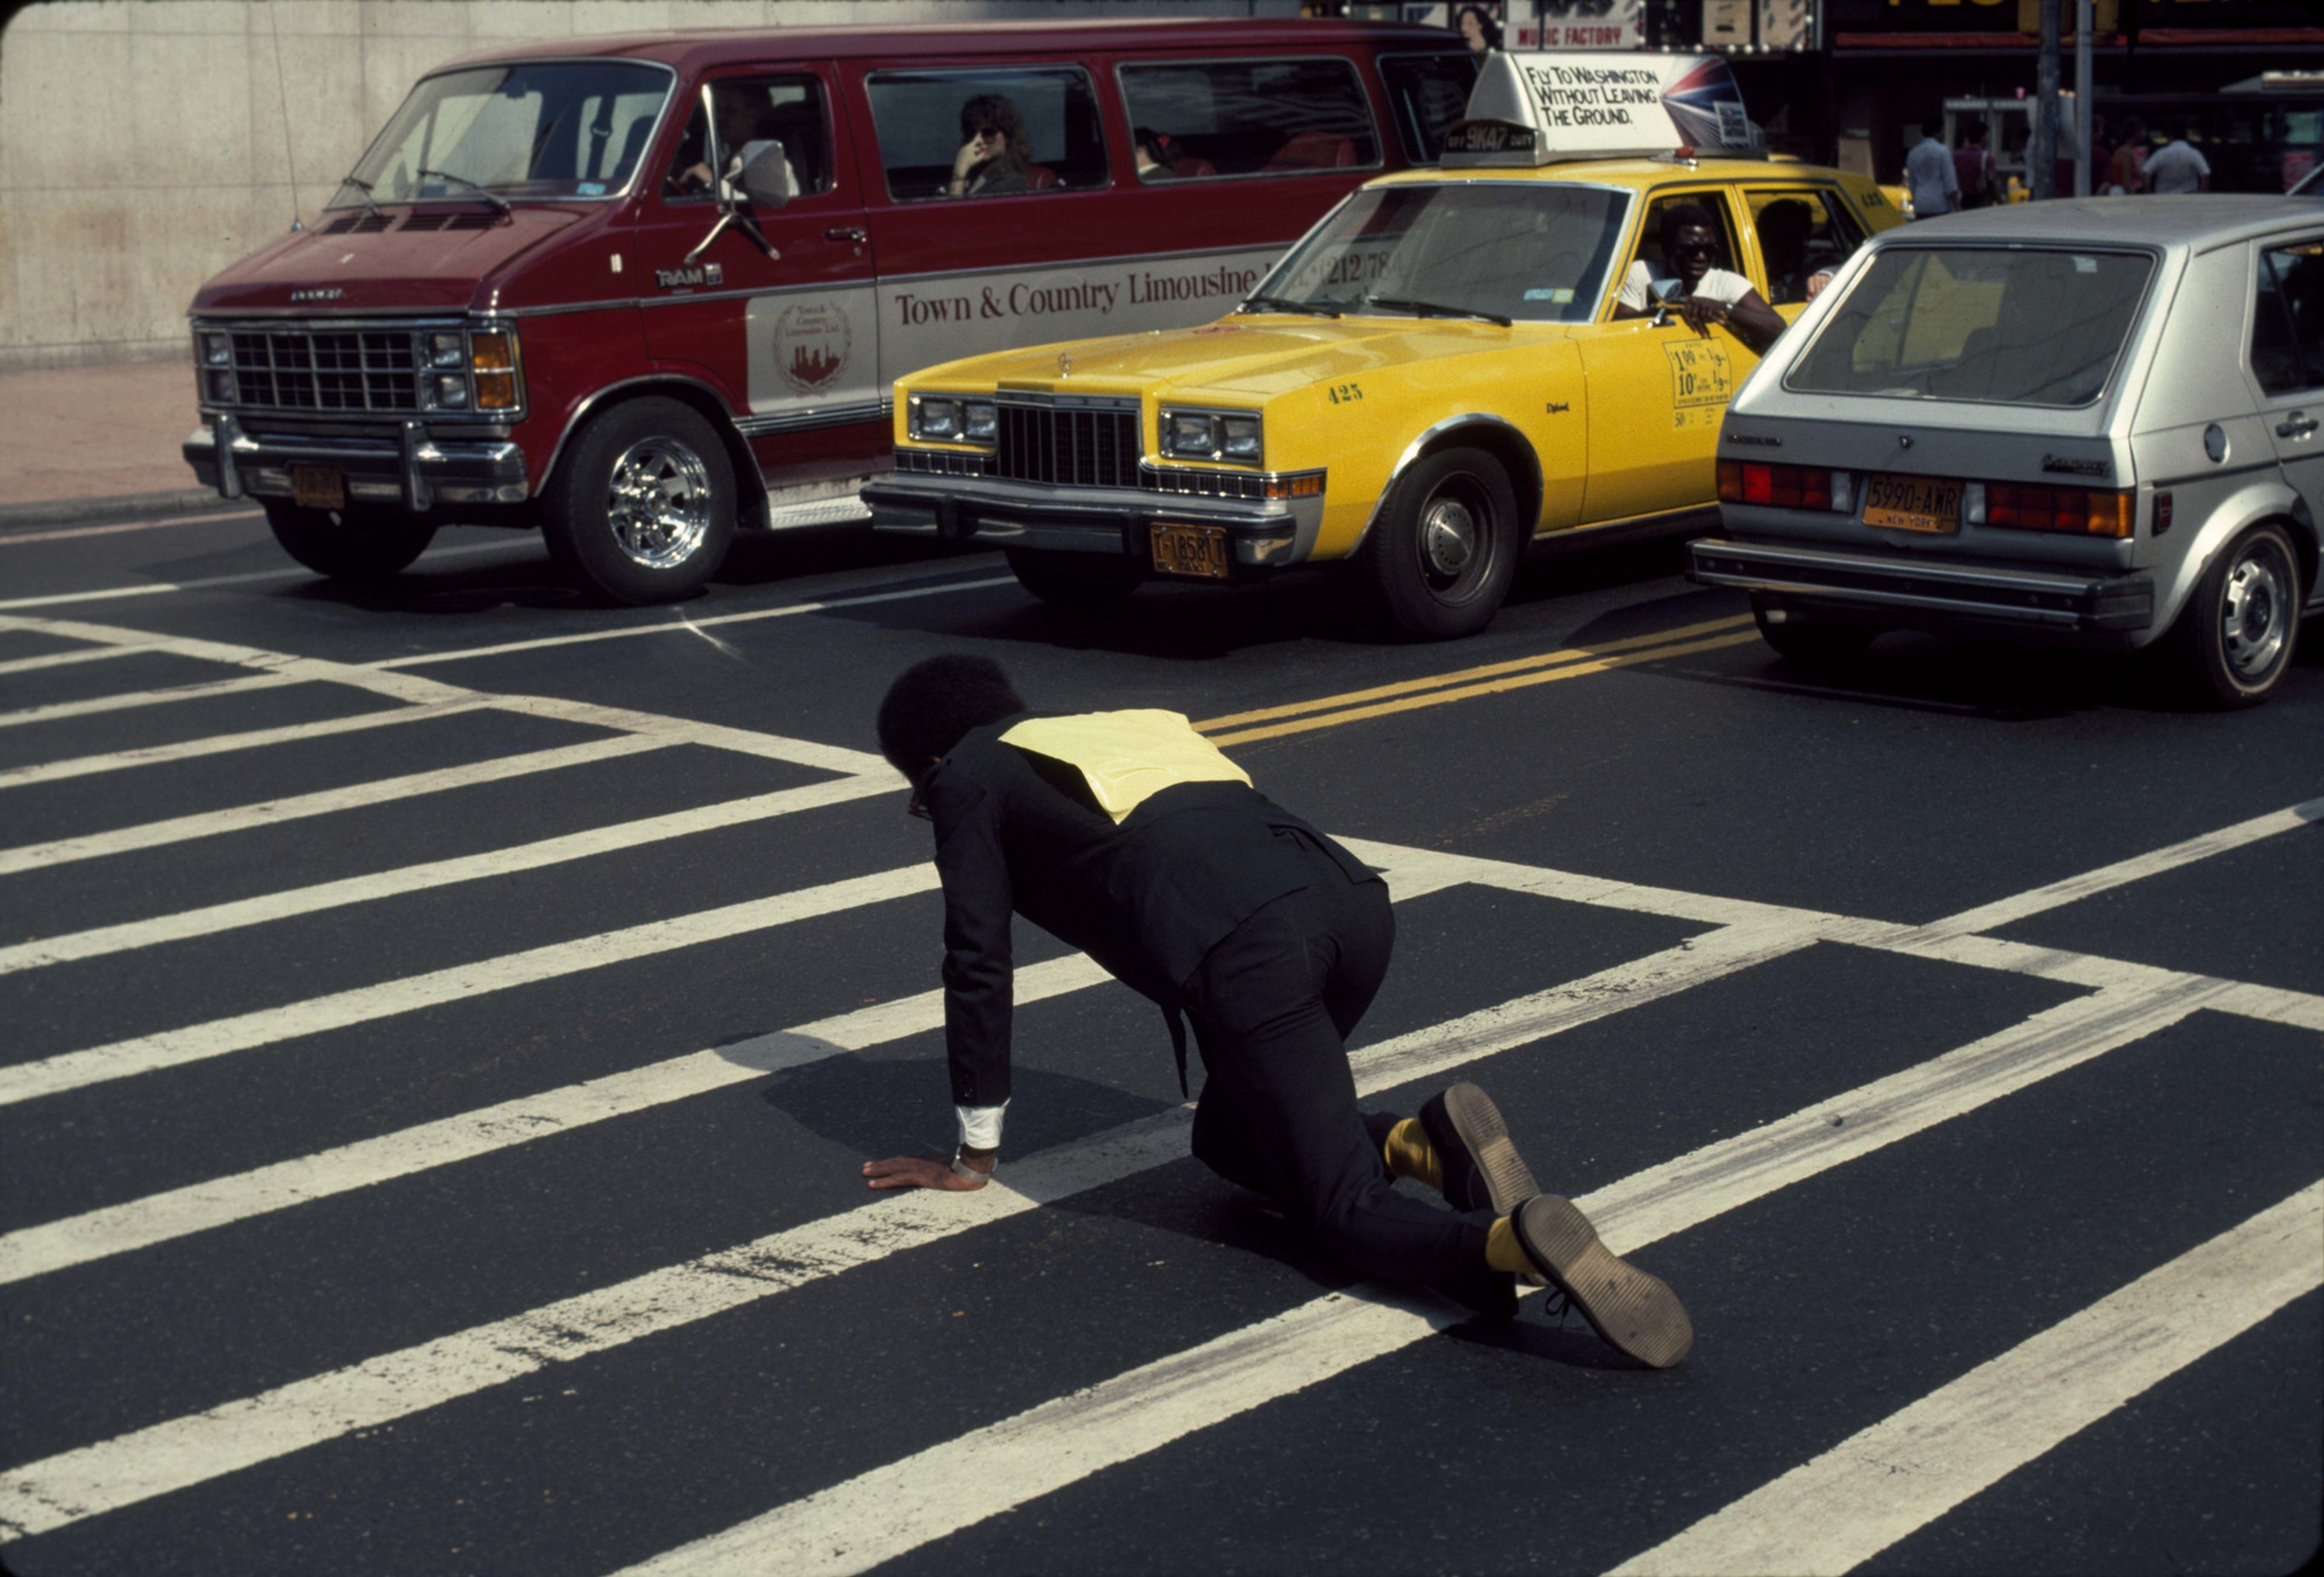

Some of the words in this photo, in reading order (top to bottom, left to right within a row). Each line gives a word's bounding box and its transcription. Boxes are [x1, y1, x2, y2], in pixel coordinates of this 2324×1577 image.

[1518, 27, 1558, 46] MUIC
[1564, 26, 1622, 45] FACTORY
[1525, 67, 1551, 85] FLY
[1550, 67, 1572, 85] TO
[1569, 67, 1659, 85] WASHINGTON
[1534, 86, 1600, 105] WITHOUT
[1600, 85, 1658, 104] LEAVING
[1541, 107, 1572, 127] THE
[1572, 105, 1633, 125] GROUND.
[1466, 125, 1508, 151] 9K47
[656, 269, 704, 288] RAM
[895, 294, 971, 326] Town
[980, 286, 1005, 320] &
[1009, 279, 1120, 315] Country
[1128, 265, 1258, 305] Limousine
[1328, 383, 1363, 404] 425
[1870, 481, 1957, 516] 5990-AWR
[1887, 512, 1906, 524] NEW
[1909, 514, 1934, 527] YORK
